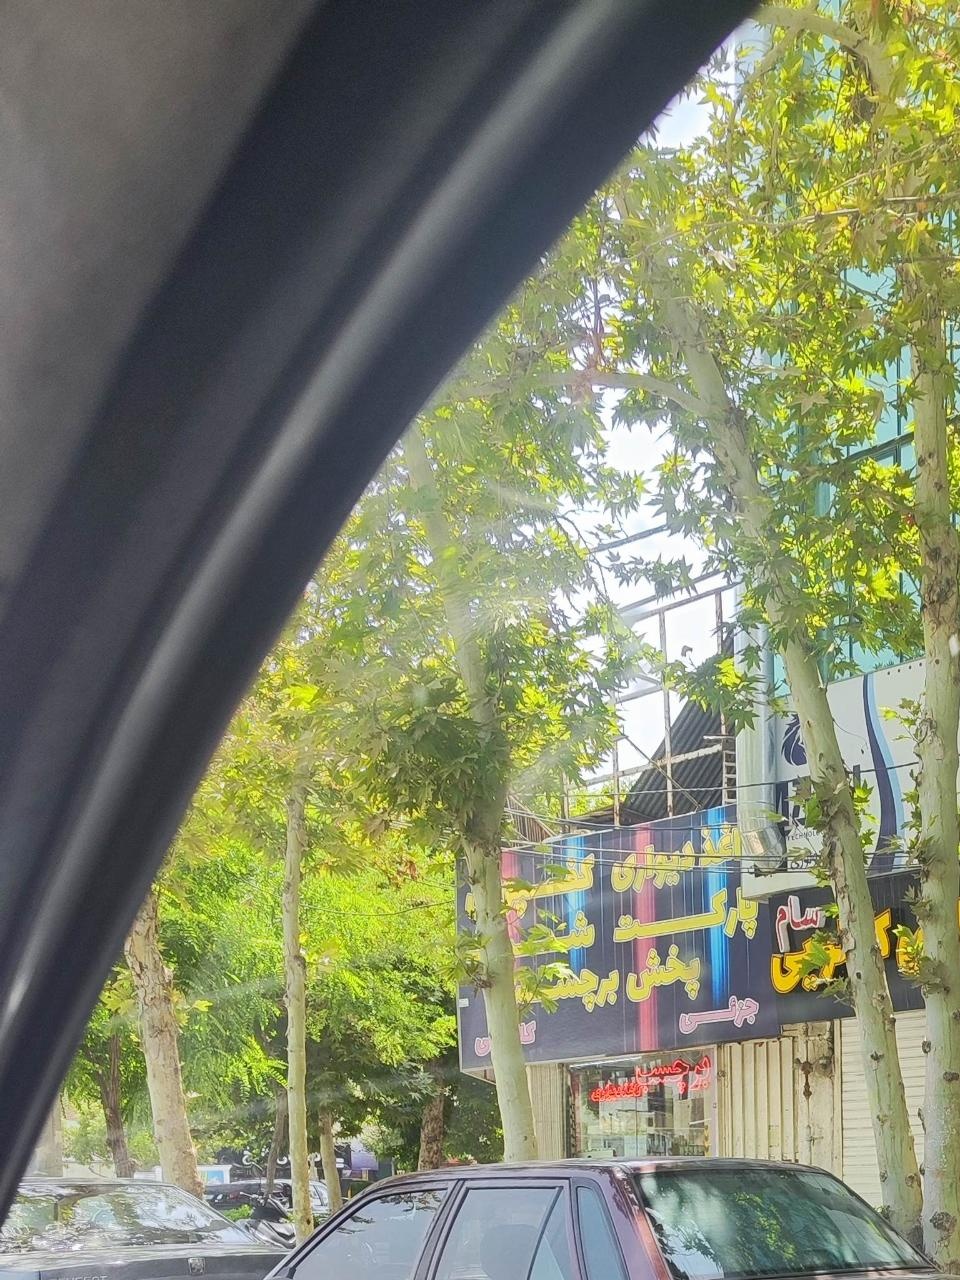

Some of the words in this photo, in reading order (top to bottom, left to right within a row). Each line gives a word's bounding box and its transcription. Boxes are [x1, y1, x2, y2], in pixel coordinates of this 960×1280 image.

[610, 840, 695, 894] دیواری
[699, 822, 742, 868] اغذ
[626, 944, 701, 1002] پخش
